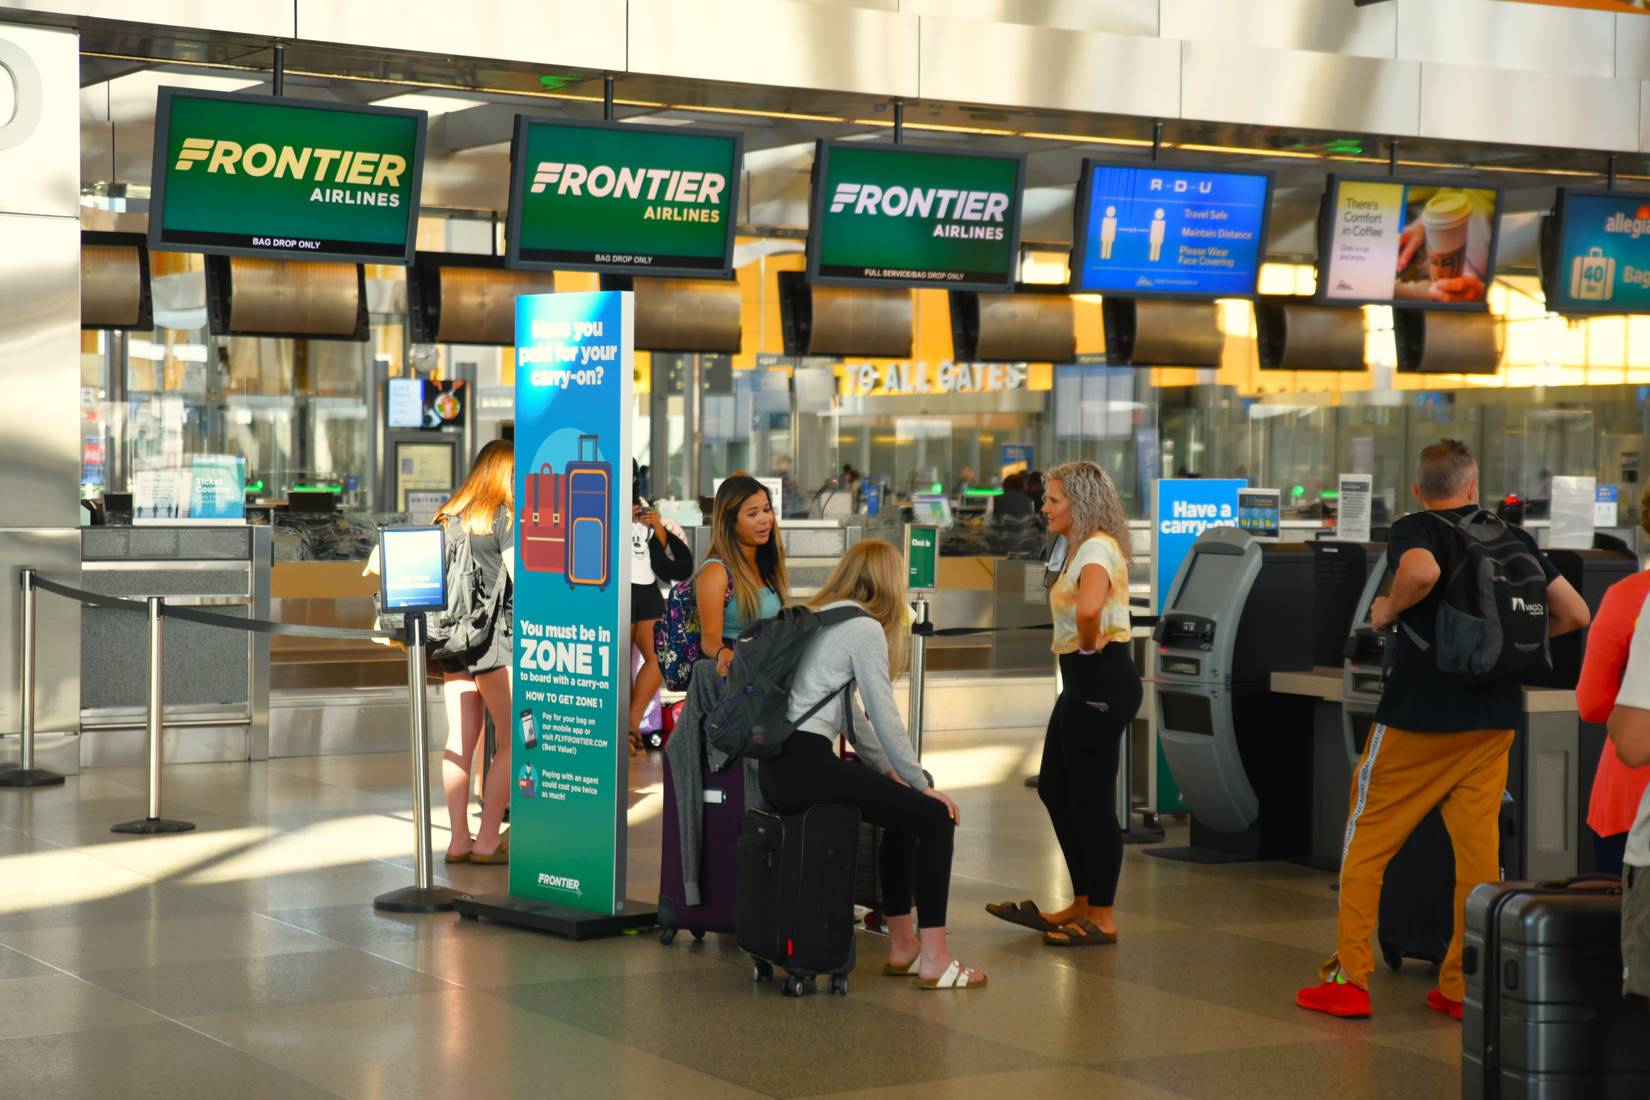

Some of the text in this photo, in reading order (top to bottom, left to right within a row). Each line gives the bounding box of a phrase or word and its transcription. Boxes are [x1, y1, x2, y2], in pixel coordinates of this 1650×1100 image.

[175, 137, 407, 187] FRONTIER
[530, 162, 725, 204] FRONTIER
[310, 187, 400, 207] AIRLINES
[830, 182, 1009, 222] FRONTIER
[1346, 198, 1379, 209] There's
[643, 206, 720, 223] AIRLINES
[1185, 208, 1228, 220] Travel Safe
[1344, 212, 1382, 224] Comfort
[933, 224, 1004, 240] AIRLINES
[1182, 228, 1252, 240] Maintain Distance
[1342, 226, 1383, 238] in Coffee
[252, 237, 321, 250] BAG DROP ONLY
[1208, 247, 1228, 256] Wear
[595, 254, 652, 264] BAG DROP ONLY
[1178, 256, 1234, 268] Face Covering
[864, 268, 881, 276] FULL
[928, 272, 946, 280] DROP
[947, 272, 964, 280] ONLY
[1584, 266, 1603, 282] 40
[574, 321, 603, 341] you
[555, 342, 578, 361] for
[581, 345, 618, 364] your
[530, 366, 604, 389] carry-on?
[846, 360, 1022, 391] TO ALL GATES
[1172, 500, 1232, 518] Have a
[520, 620, 610, 642] You must be in
[520, 638, 610, 676] ZONE 1
[520, 671, 609, 690] to board with a carry-on
[526, 690, 603, 708] HOW TO GET ZONE 1
[542, 712, 552, 721] Pay
[576, 716, 587, 726] bag
[552, 725, 571, 733] mobile
[554, 734, 608, 748] FLYFRONTIER.COM
[542, 769, 560, 780] Paying
[562, 772, 574, 780] with
[583, 776, 599, 784] agent
[542, 781, 557, 789] could
[538, 872, 580, 890] FRONTIER
